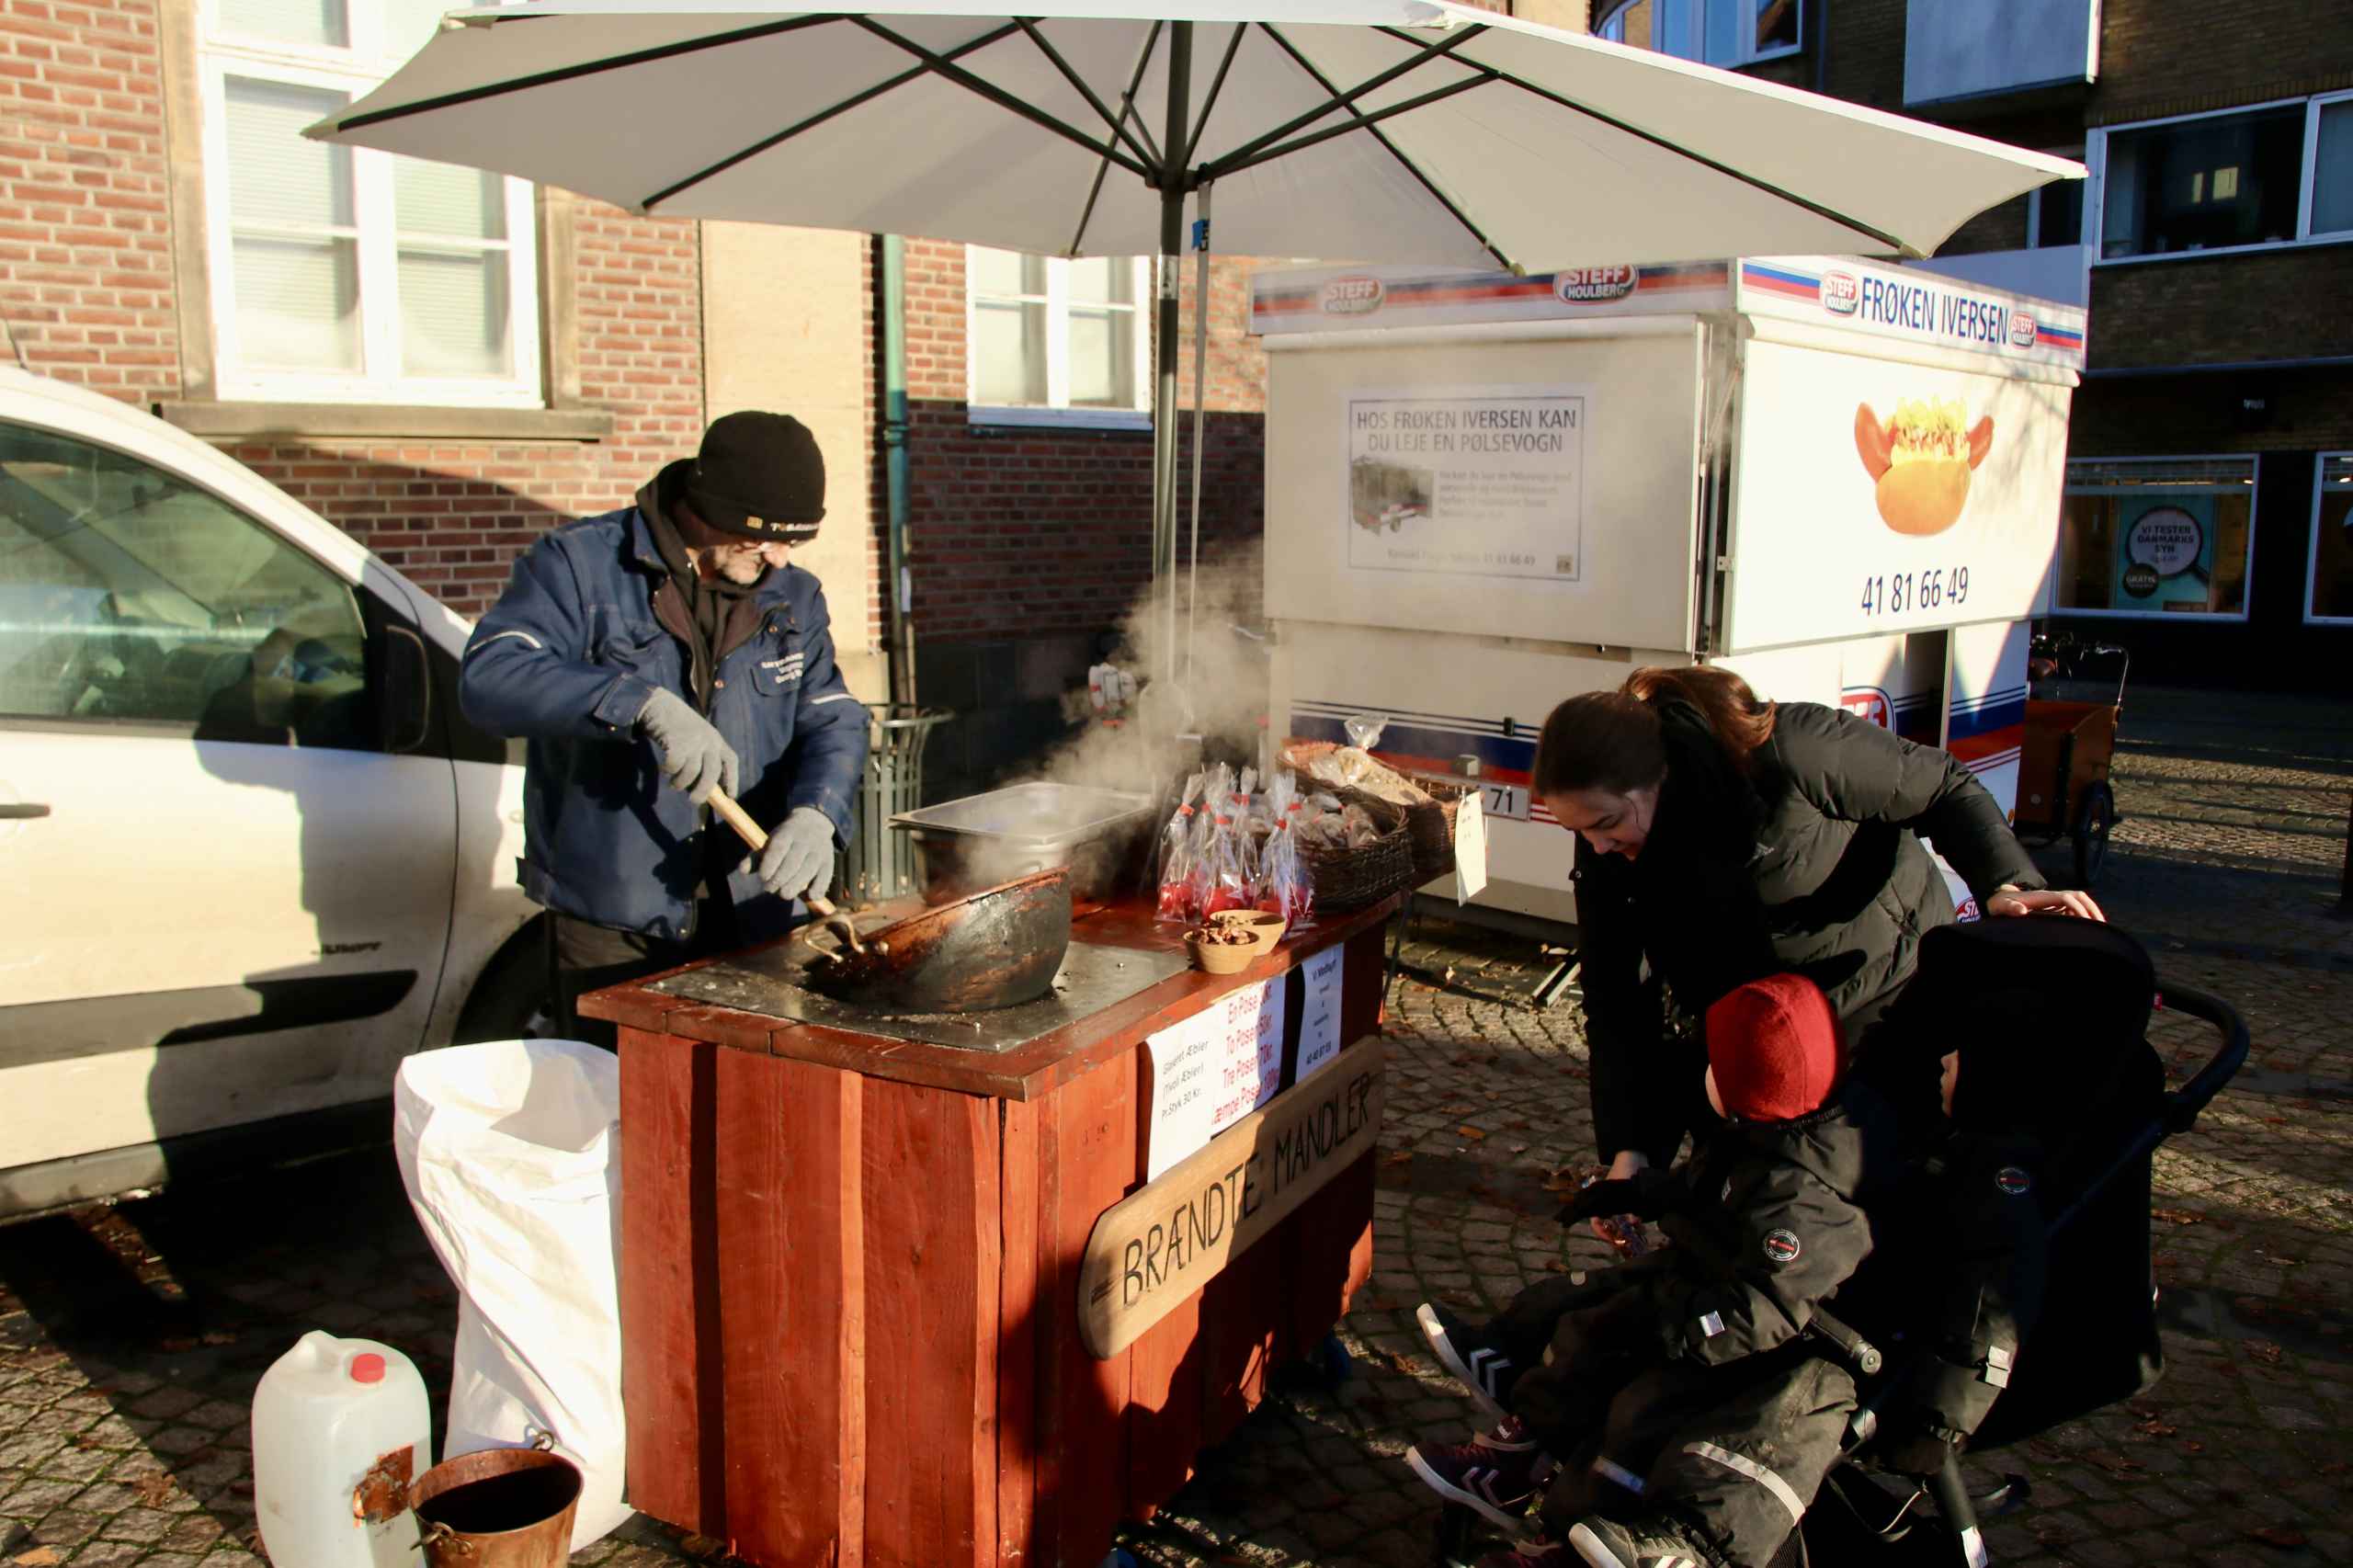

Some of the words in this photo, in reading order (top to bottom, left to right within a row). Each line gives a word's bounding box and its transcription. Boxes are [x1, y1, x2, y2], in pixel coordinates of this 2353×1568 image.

[1568, 265, 1626, 285] STEFF
[1330, 279, 1374, 300] STEFF
[1567, 282, 1626, 300] HOULBERG
[1827, 278, 1855, 300] STEFF
[1861, 277, 1937, 332] FRØKEN
[1941, 294, 2009, 345] IVERSEN
[1357, 411, 1390, 429] HOS
[1393, 411, 1457, 429] FRØKEN
[1462, 410, 1532, 429] IVERSEN
[1539, 409, 1576, 428] KAN
[1368, 433, 1390, 452] DU
[1394, 433, 1427, 452] LEJE
[1433, 434, 1455, 452] EN
[1461, 433, 1563, 453] PØLSEVOGN
[2137, 534, 2195, 544] DANMARKS
[1861, 575, 1882, 616] 41
[1892, 573, 1912, 613] 81
[1920, 570, 1941, 609] 66
[1947, 566, 1969, 605] 49
[1490, 788, 1514, 812] 71
[1228, 1001, 1237, 1024] En
[1186, 1040, 1209, 1058] Æbler
[1226, 1035, 1235, 1056] To
[1211, 1096, 1240, 1125] æmpe
[1123, 1152, 1264, 1307] BRÆNDTE
[1274, 1071, 1373, 1195] MANDLER
